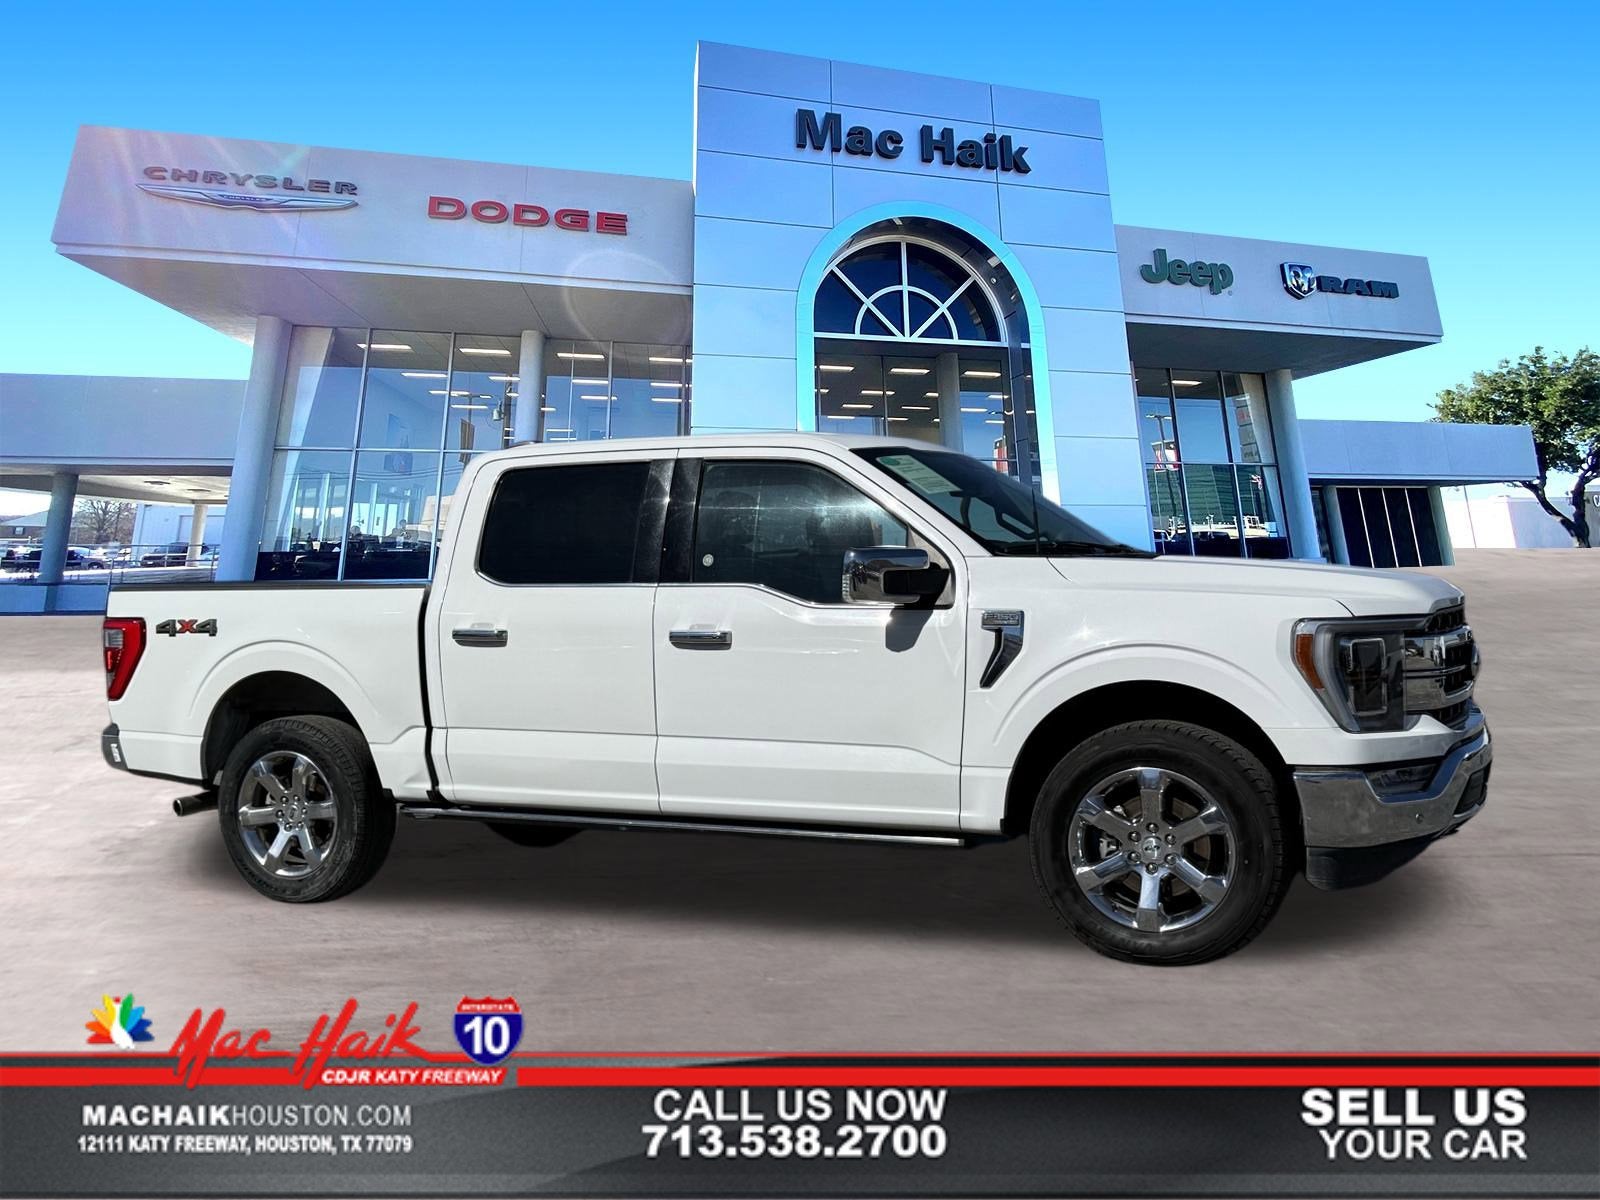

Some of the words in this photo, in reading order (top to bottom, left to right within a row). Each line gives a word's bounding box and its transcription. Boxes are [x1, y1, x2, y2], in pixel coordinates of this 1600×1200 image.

[796, 108, 904, 159] Mac
[919, 124, 1032, 174] Haik
[143, 166, 358, 196] CHRYSLER
[427, 195, 628, 236] DODGE
[1140, 248, 1234, 296] Jeep
[1316, 275, 1399, 299] RAM
